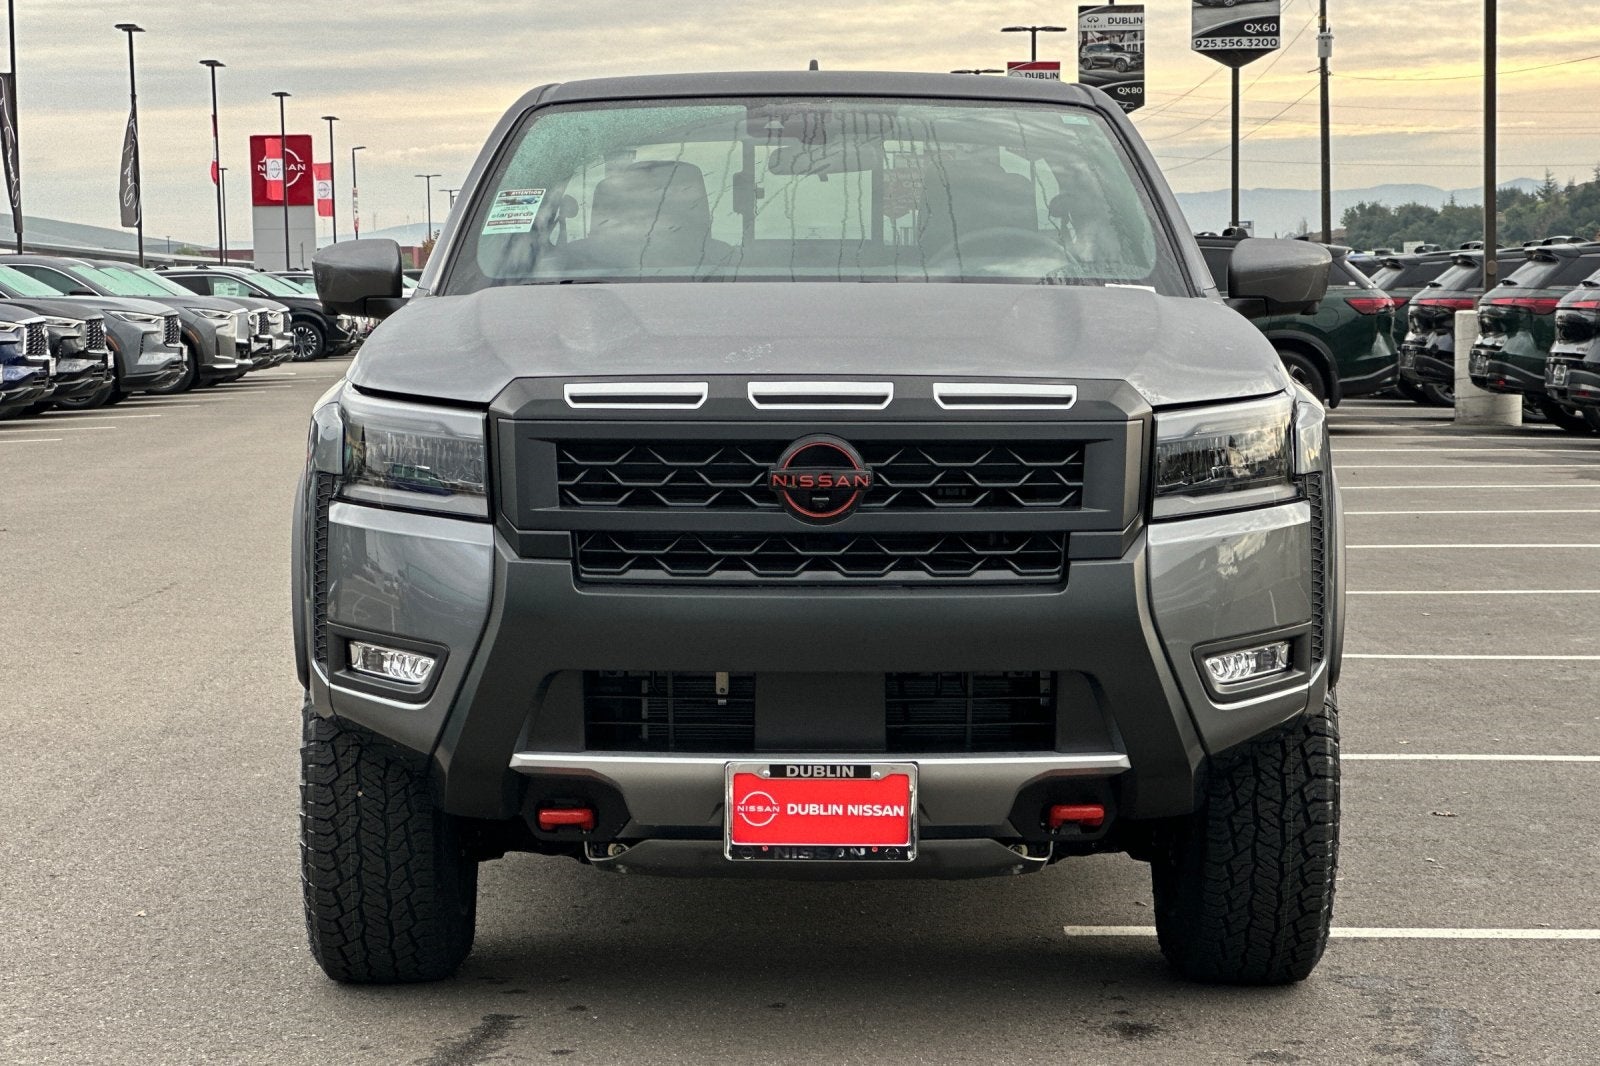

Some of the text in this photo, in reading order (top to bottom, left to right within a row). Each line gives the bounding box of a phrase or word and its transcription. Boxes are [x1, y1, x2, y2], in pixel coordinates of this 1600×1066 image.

[1243, 23, 1277, 34] QX60
[1194, 38, 1278, 48] 925.556.3200
[1025, 72, 1059, 80] DUBLIN
[1117, 86, 1143, 95] QX80
[772, 474, 870, 488] NISSAN
[786, 765, 855, 778] DUBLIN
[737, 805, 780, 813] NISSAN
[787, 803, 904, 817] DUBLIN NISSAN
[774, 847, 866, 859] NISSAN
